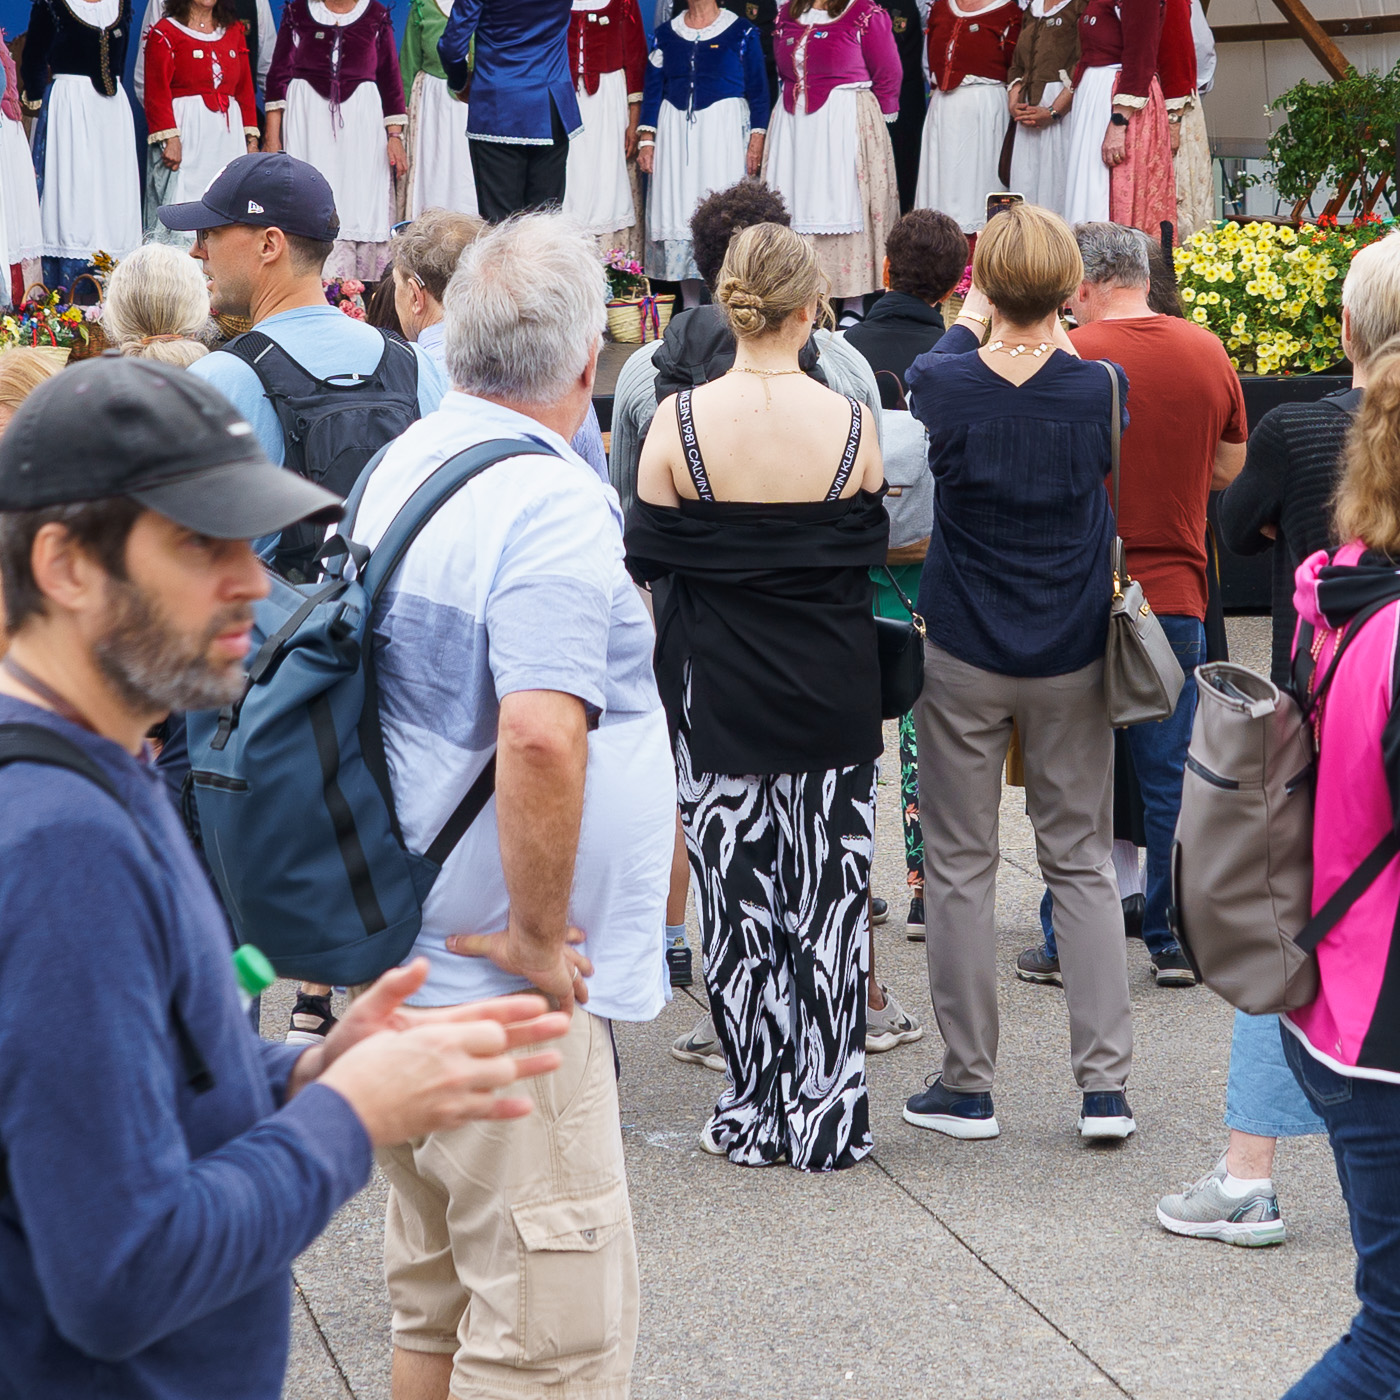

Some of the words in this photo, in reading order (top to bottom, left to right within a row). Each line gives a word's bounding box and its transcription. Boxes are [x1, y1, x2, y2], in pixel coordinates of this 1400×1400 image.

[682, 421, 696, 447] 1981
[688, 448, 709, 493] CALVIN
[827, 473, 847, 501] ALVIN
[840, 440, 857, 472] KLEIN
[850, 417, 860, 440] 1981
